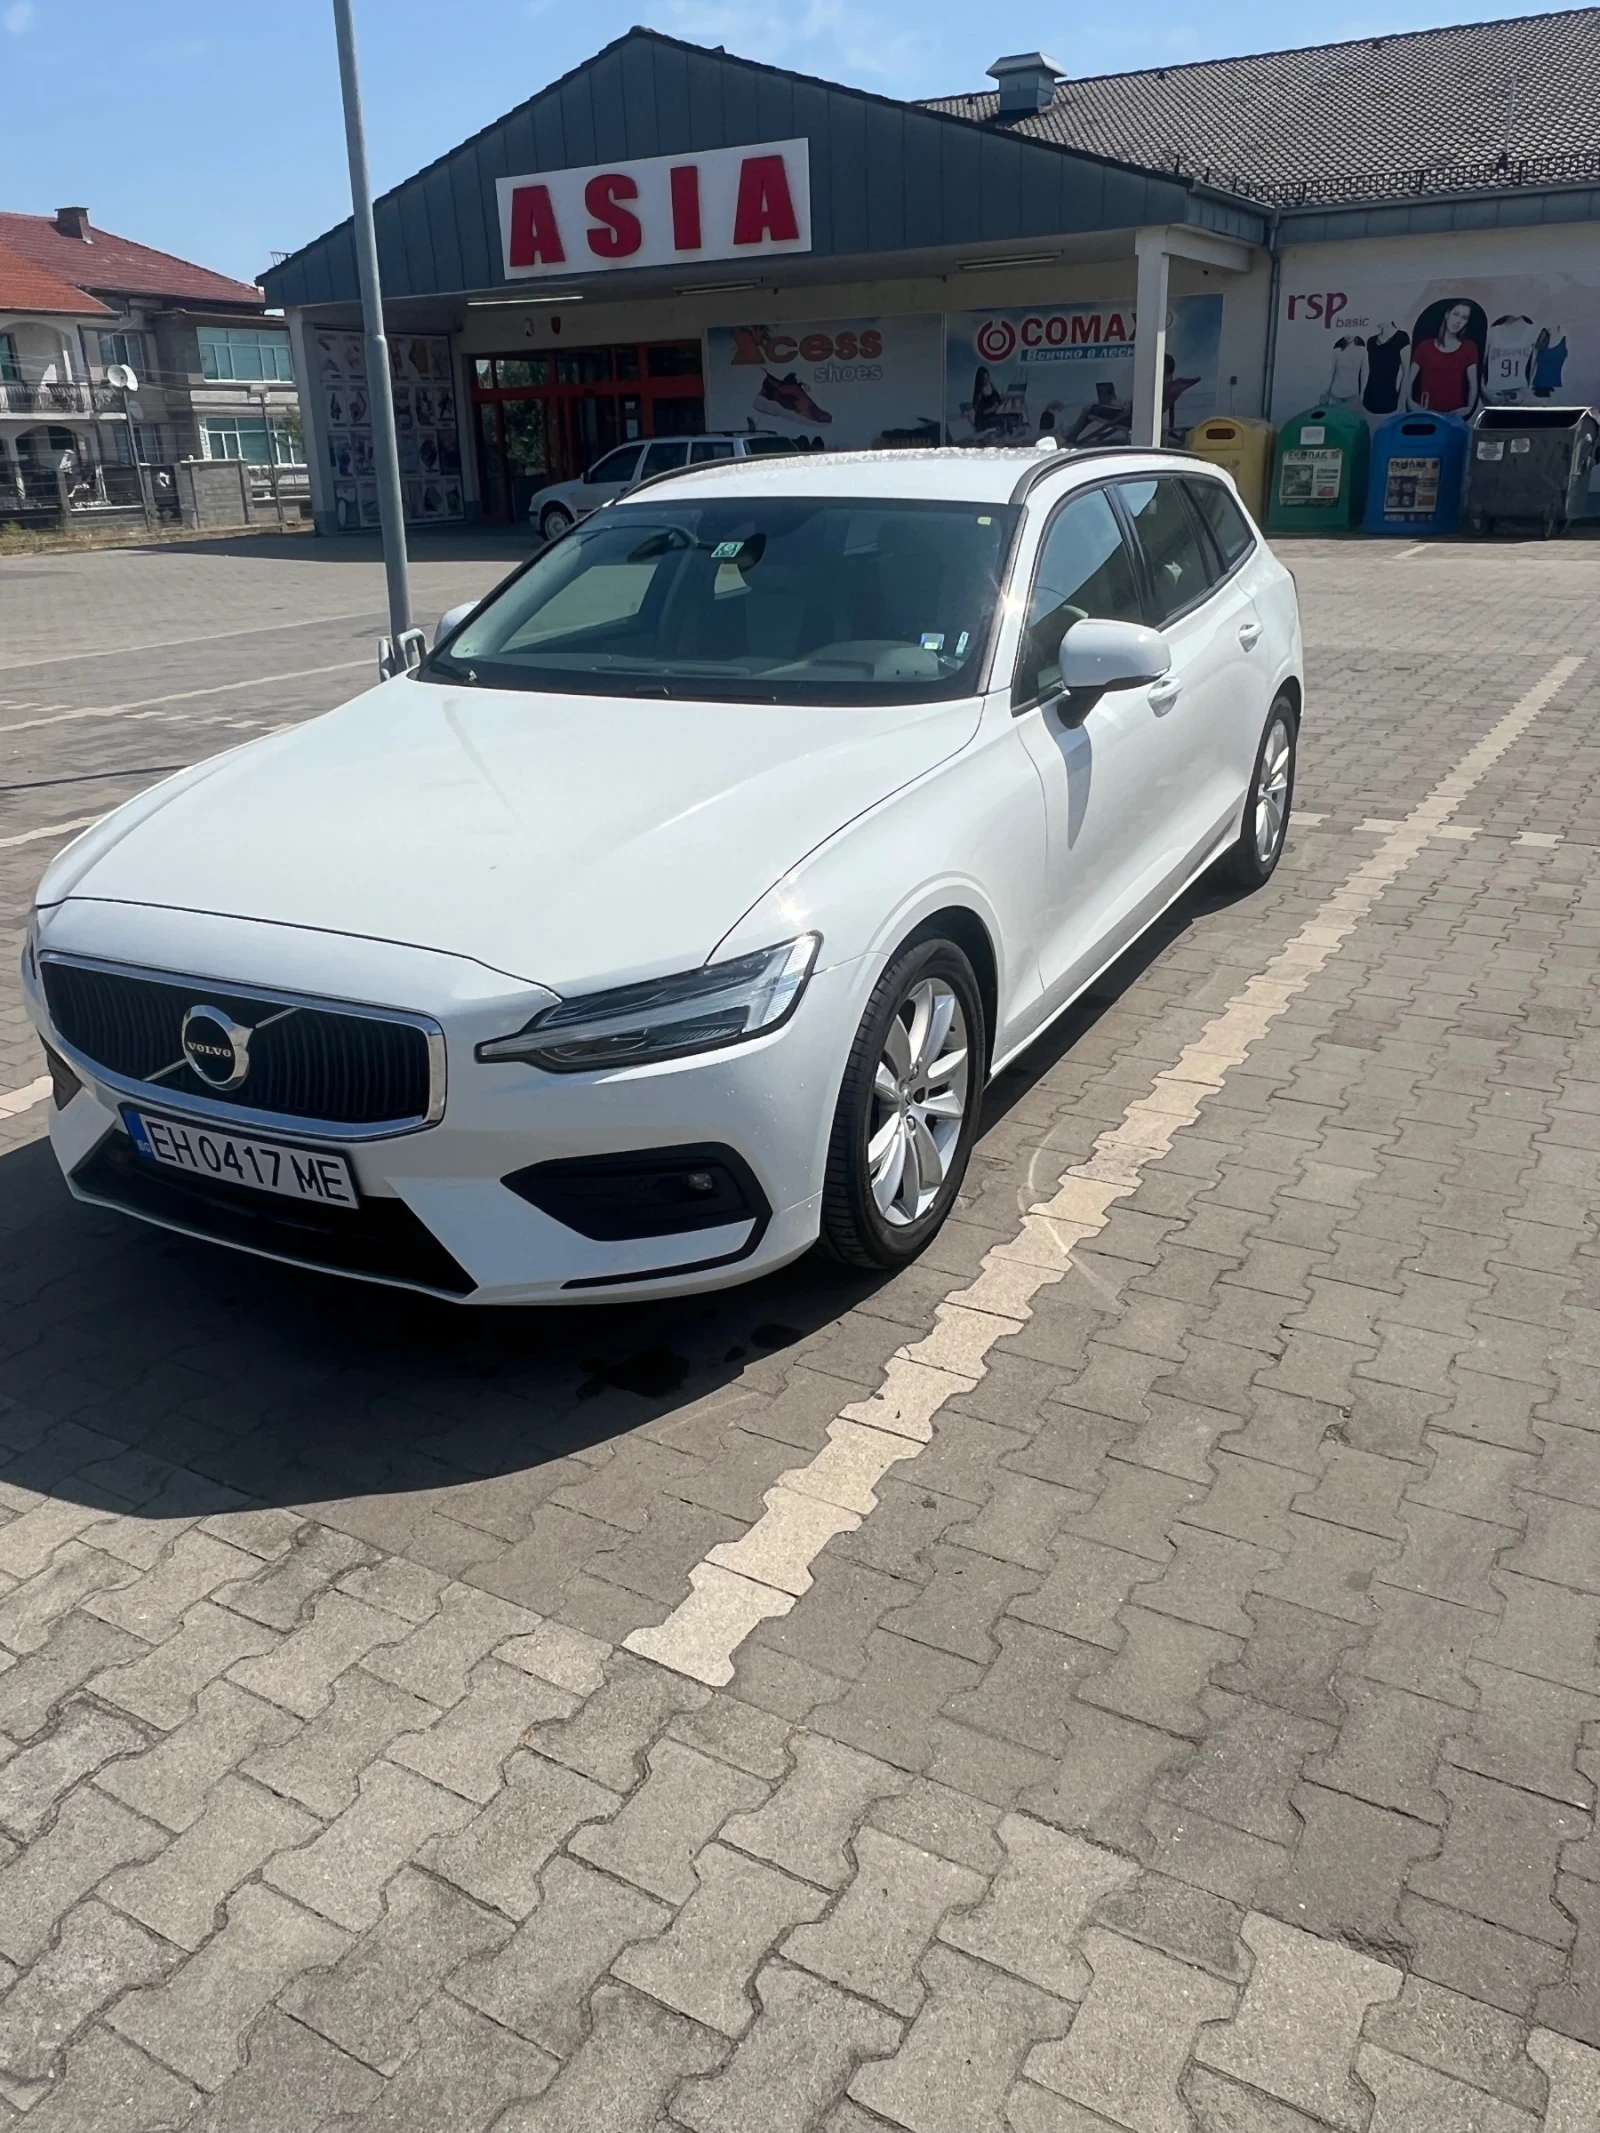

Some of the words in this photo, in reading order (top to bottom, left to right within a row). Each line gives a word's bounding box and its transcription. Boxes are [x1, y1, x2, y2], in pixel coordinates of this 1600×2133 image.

[510, 154, 799, 267] ASIA
[1287, 292, 1348, 329] rsp
[1336, 316, 1370, 328] basic
[730, 327, 883, 366] Xcess
[1099, 346, 1135, 358] лесн
[814, 363, 882, 384] shoes
[1500, 359, 1519, 378] 91
[187, 1041, 232, 1058] VOLVO
[198, 1135, 281, 1187] 0417
[290, 1154, 350, 1203] ME
